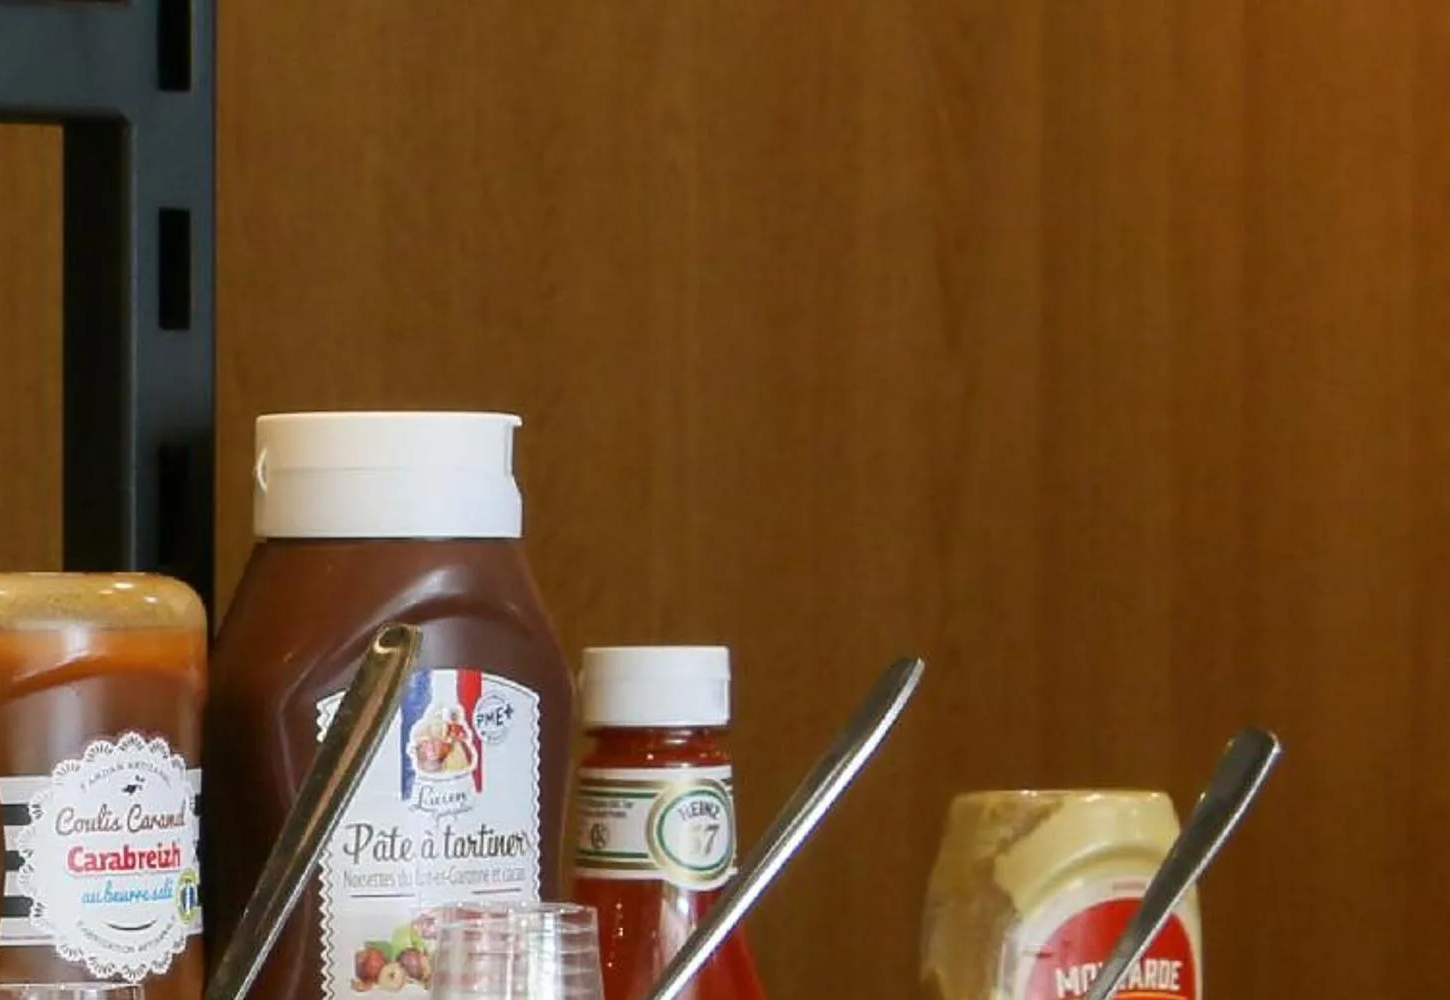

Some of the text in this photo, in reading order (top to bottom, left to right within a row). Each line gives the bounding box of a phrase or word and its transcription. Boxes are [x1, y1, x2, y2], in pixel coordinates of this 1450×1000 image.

[55, 803, 123, 836] Coulis
[678, 801, 721, 822] HEINZ
[67, 841, 181, 873] Carabreizh
[342, 822, 533, 865] Pâte à tartiner
[1056, 959, 1182, 998] MOARDE
